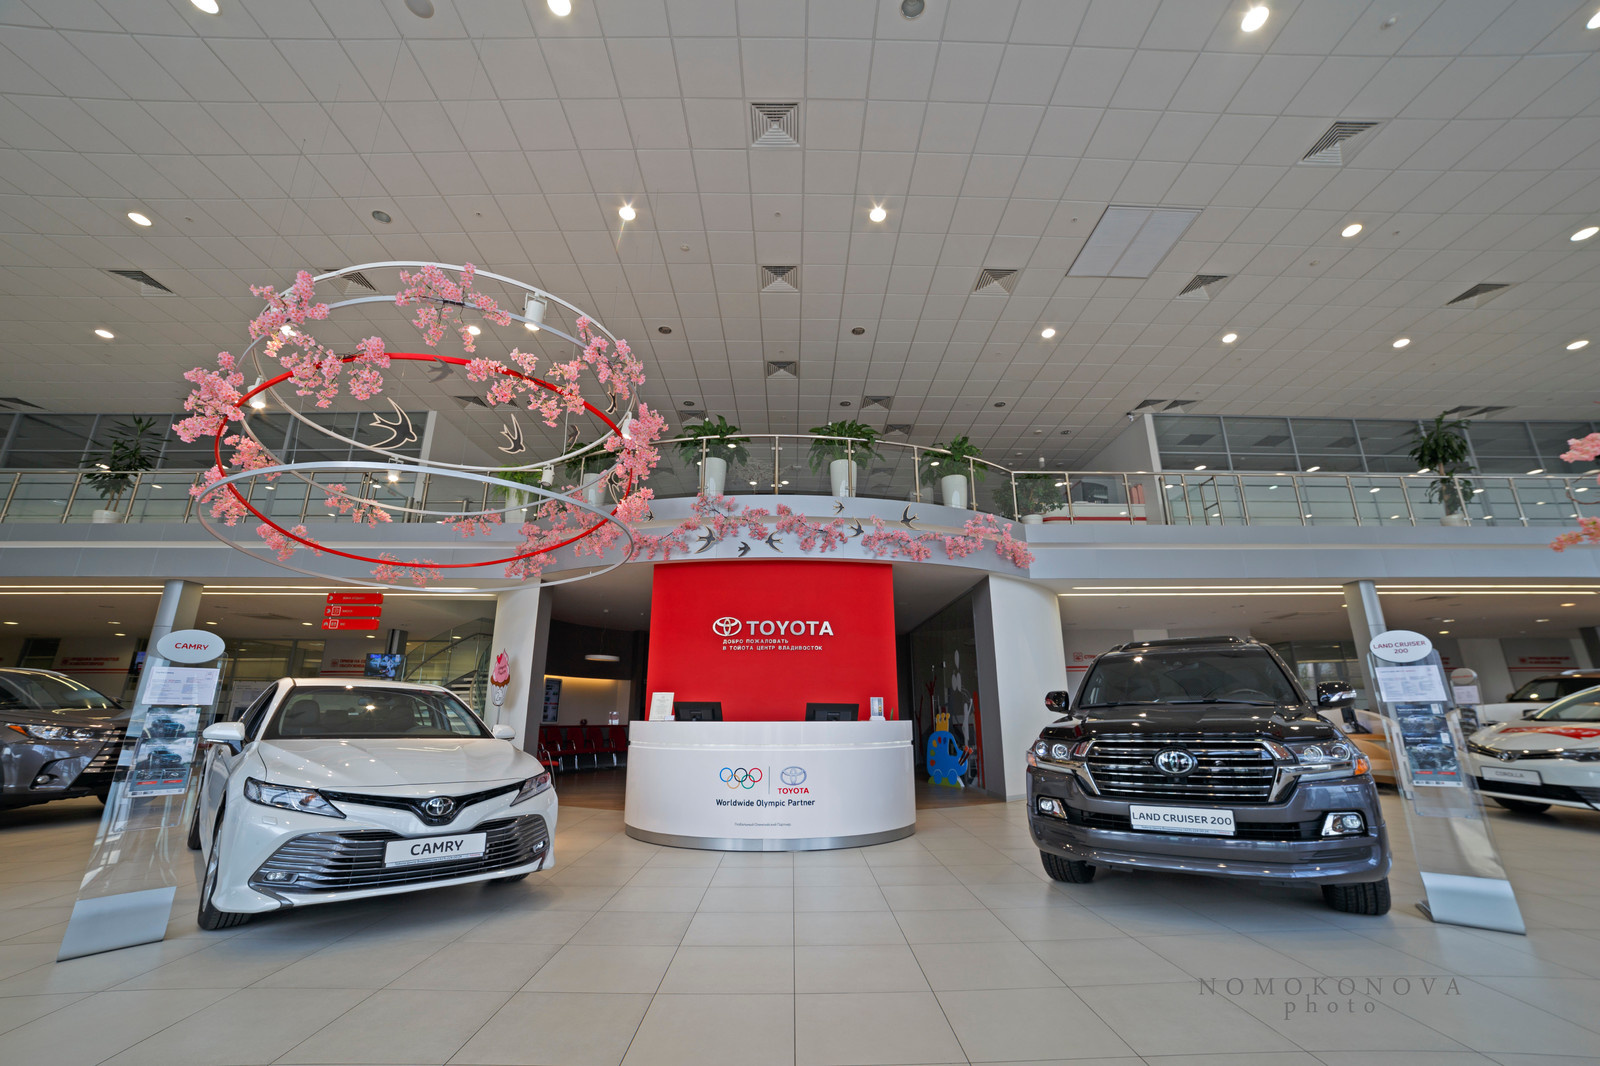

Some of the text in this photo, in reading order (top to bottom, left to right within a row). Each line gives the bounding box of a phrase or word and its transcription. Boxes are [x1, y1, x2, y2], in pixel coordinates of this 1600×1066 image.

[746, 620, 834, 636] TOYOTA
[174, 642, 209, 651] CAMRY
[1495, 769, 1525, 778] COROLLA
[777, 787, 810, 795] TOYOTA
[716, 799, 816, 808] Worldwide Olympic Partner
[1132, 812, 1232, 826] LAND CRUISER 200
[410, 840, 464, 856] CAMRY
